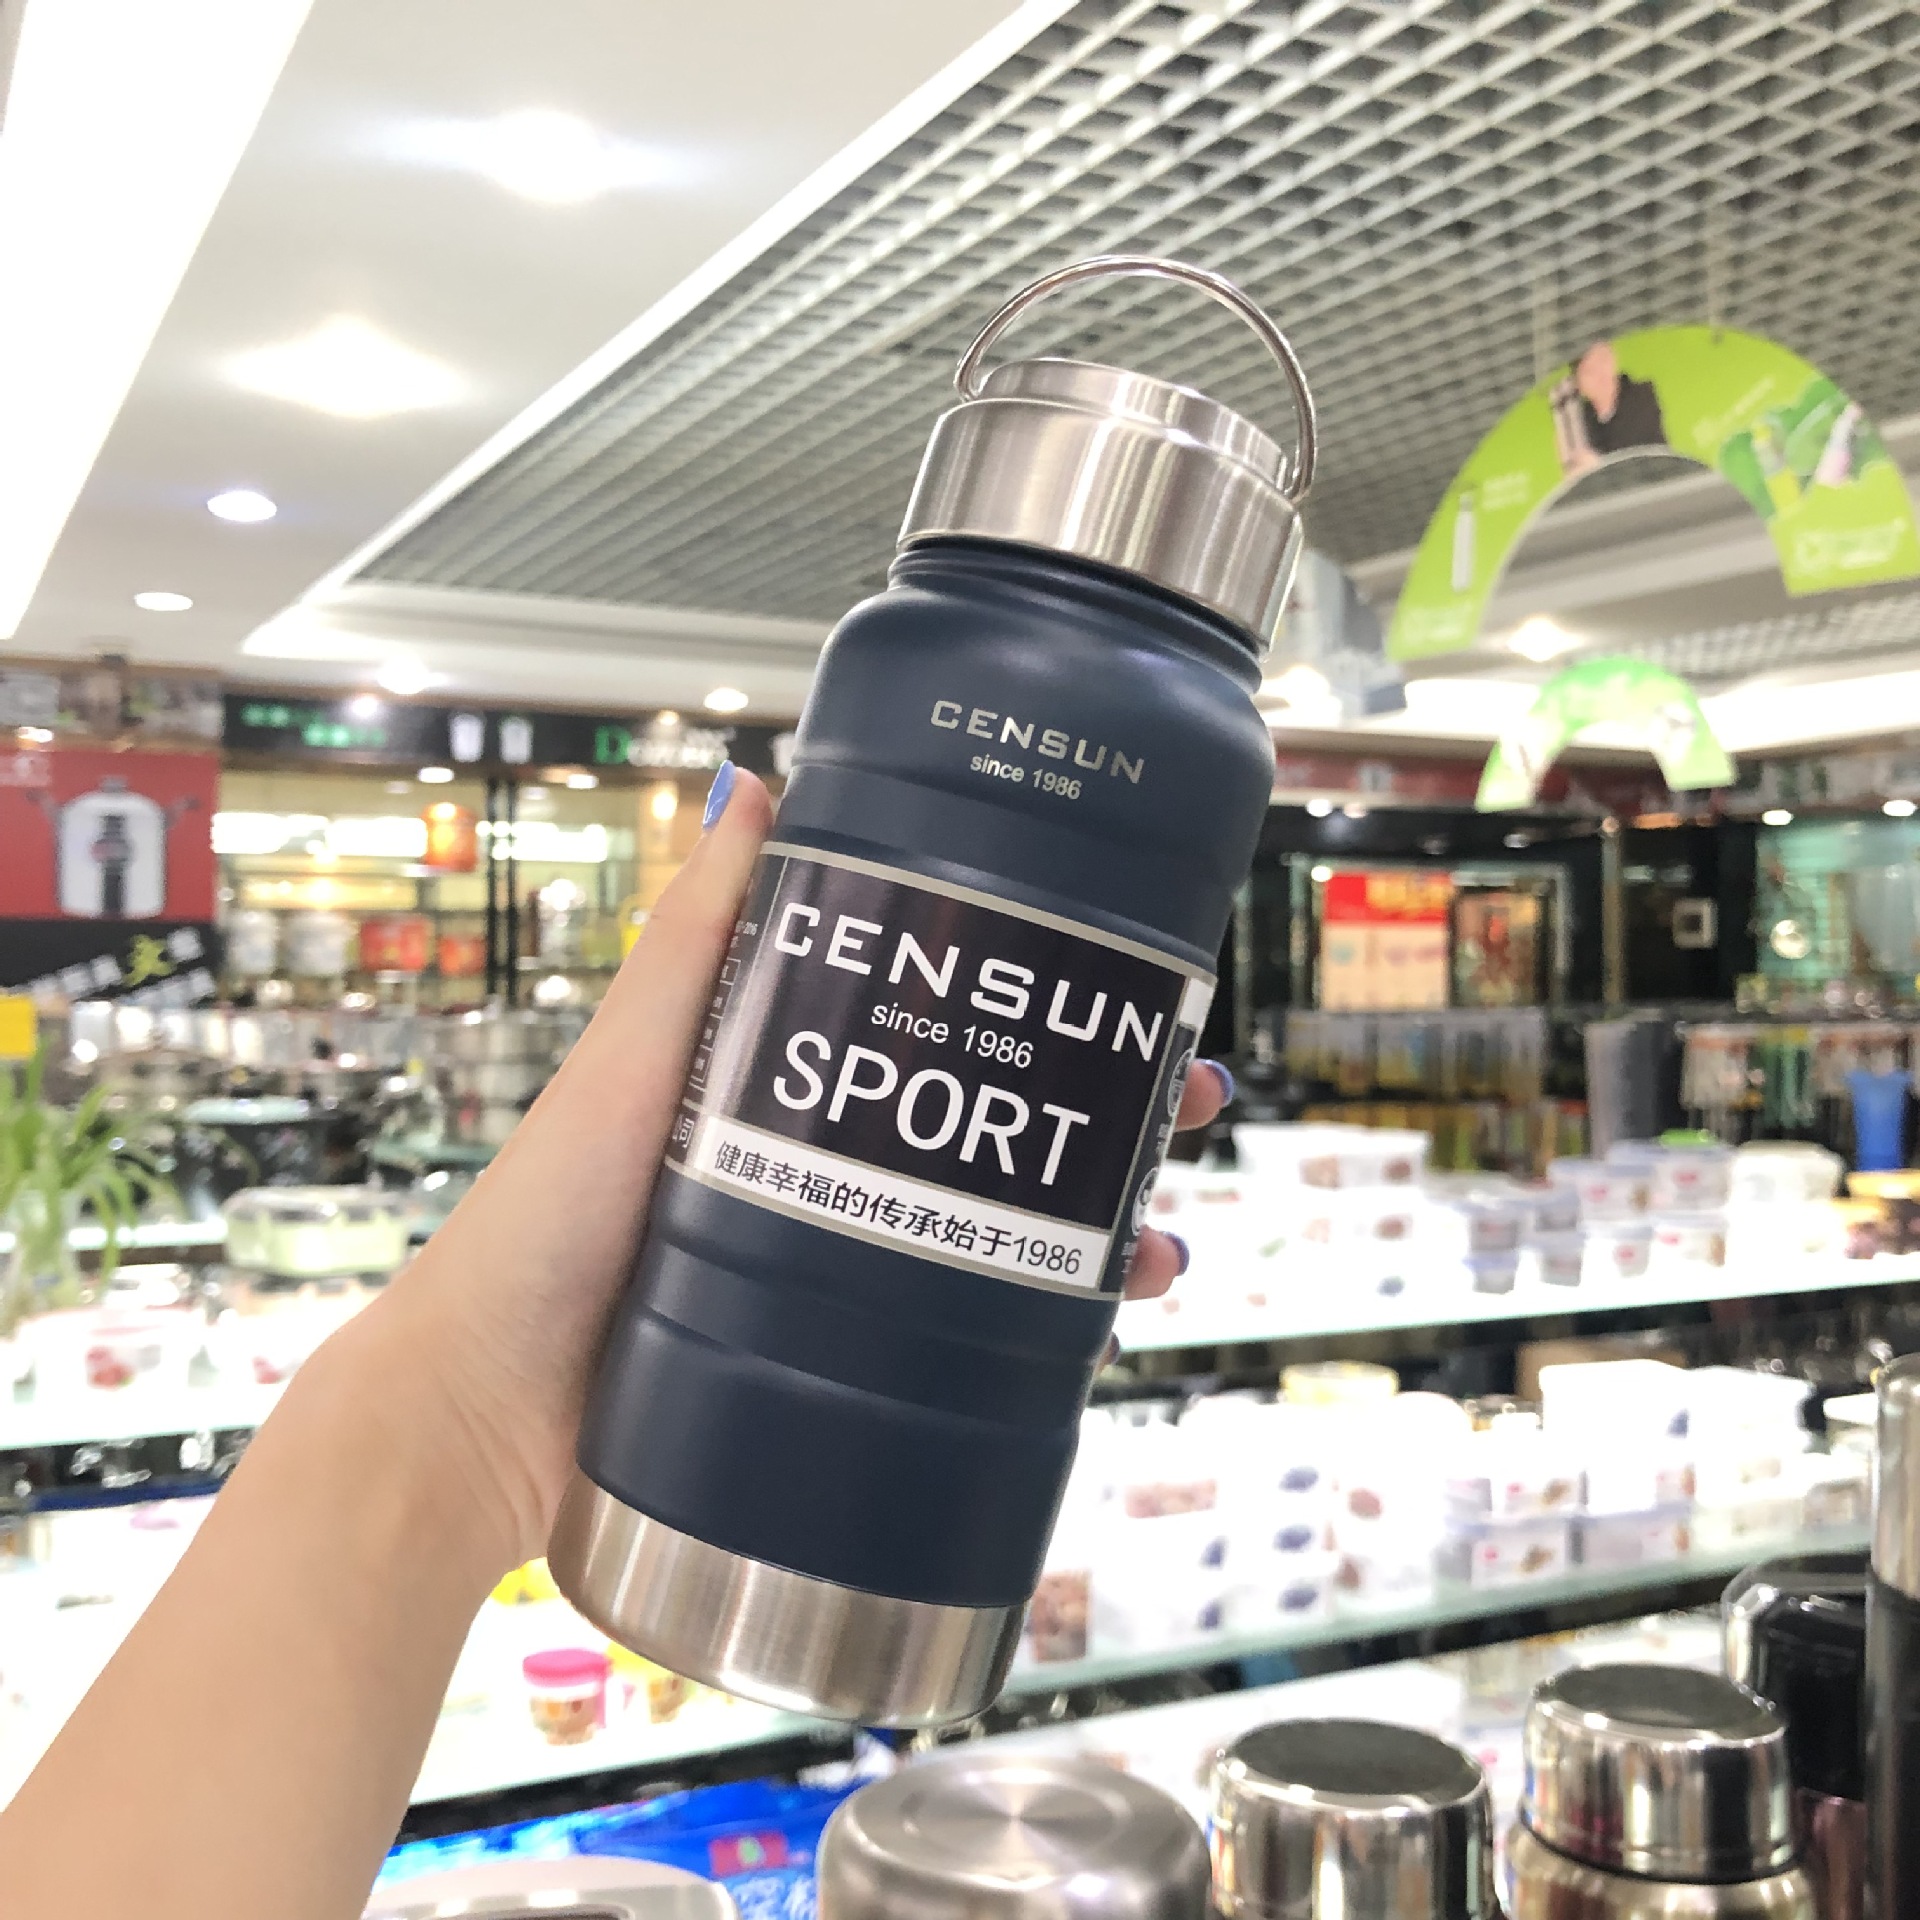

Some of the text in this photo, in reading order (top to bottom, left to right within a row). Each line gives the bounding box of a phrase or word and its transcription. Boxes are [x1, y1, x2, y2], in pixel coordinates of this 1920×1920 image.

[930, 700, 1145, 784] CENSUN
[970, 753, 1082, 800] since 1986
[774, 902, 1164, 1062] CENSUN
[871, 1002, 1035, 1068] since 1986
[773, 1031, 1091, 1186] SPORT
[716, 1140, 1084, 1275] 健康幸福的传承始于1986
